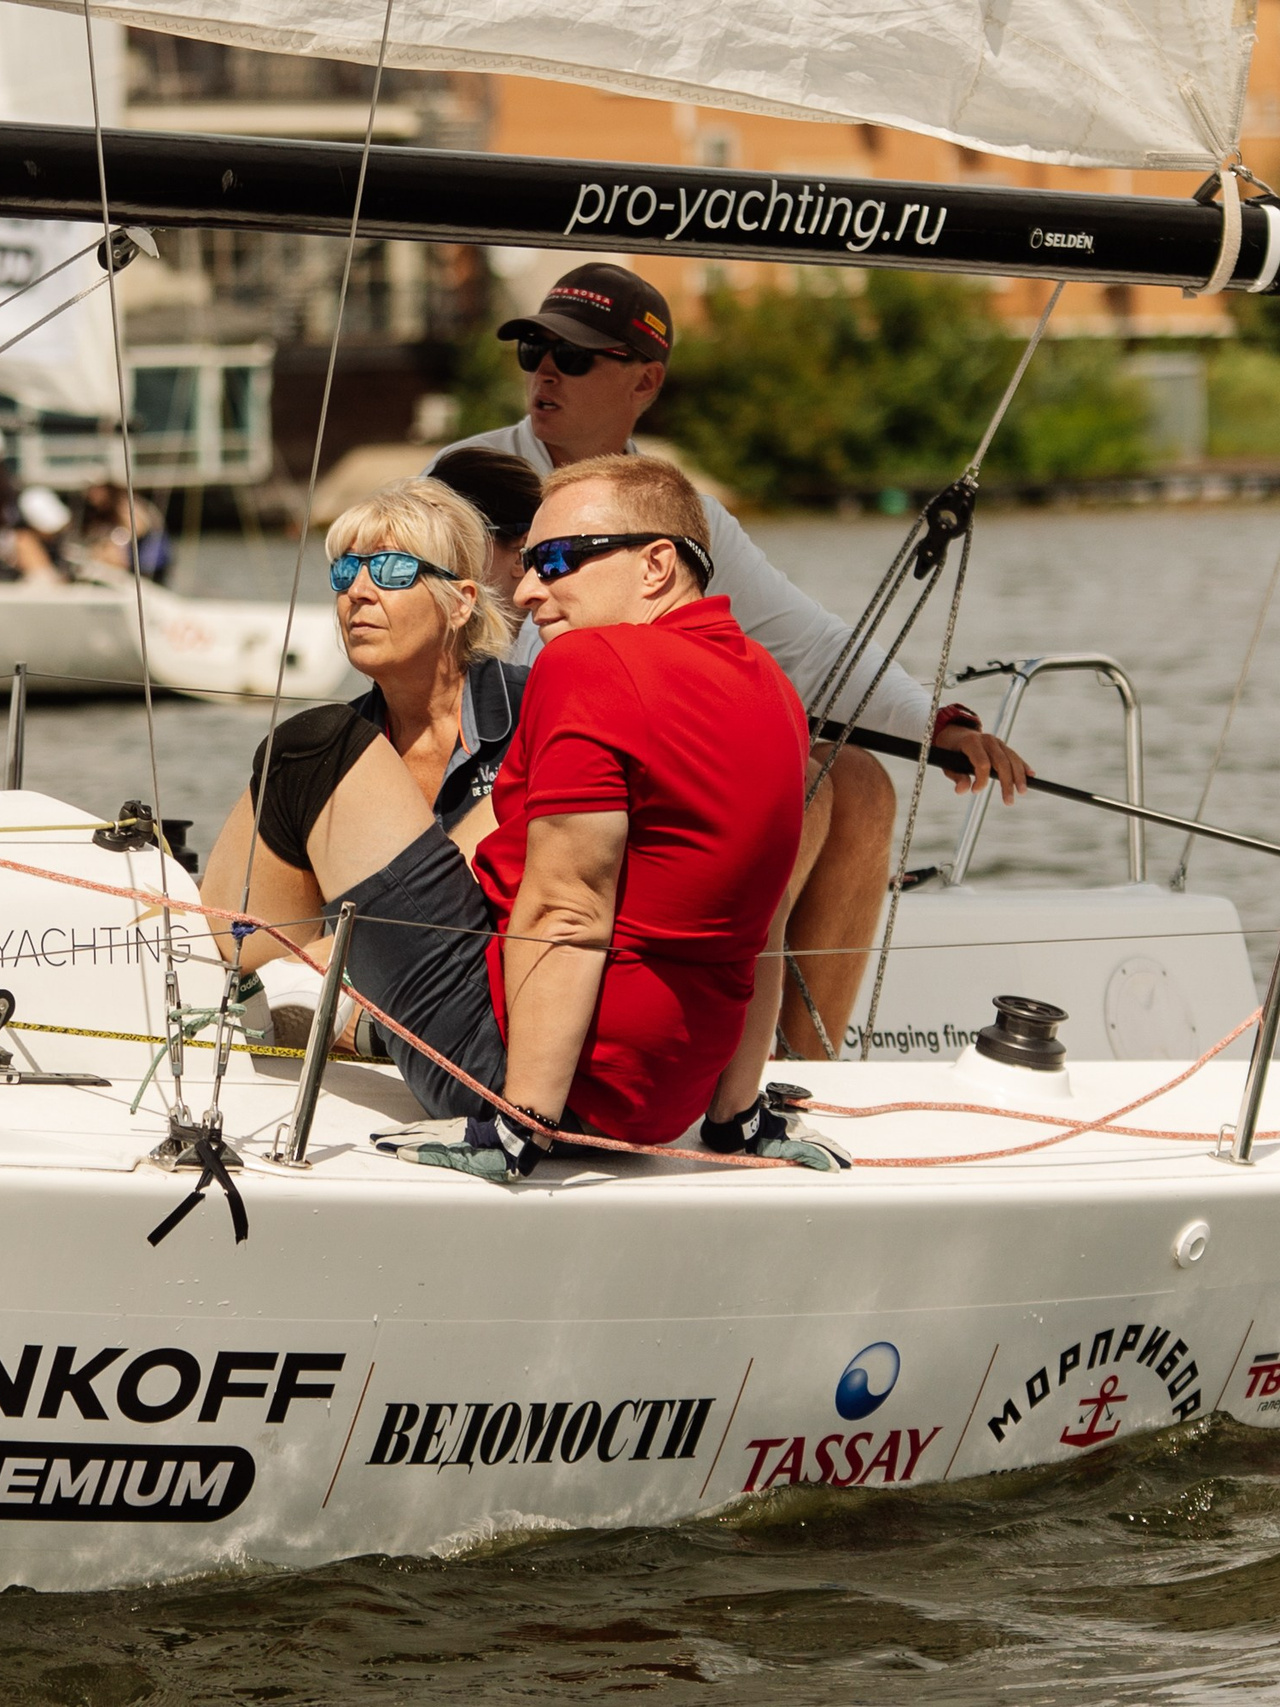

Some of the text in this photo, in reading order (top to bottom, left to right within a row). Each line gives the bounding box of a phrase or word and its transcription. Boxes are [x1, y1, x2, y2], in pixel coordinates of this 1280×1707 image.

[564, 179, 947, 252] pro-yachting.ru
[573, 288, 612, 305] ROSSA
[844, 1024, 940, 1054] Changing
[987, 1324, 1202, 1443] МОРПРИБОР
[365, 1398, 717, 1475] ВЕДОМОСТИ
[741, 1426, 944, 1493] TASSAY
